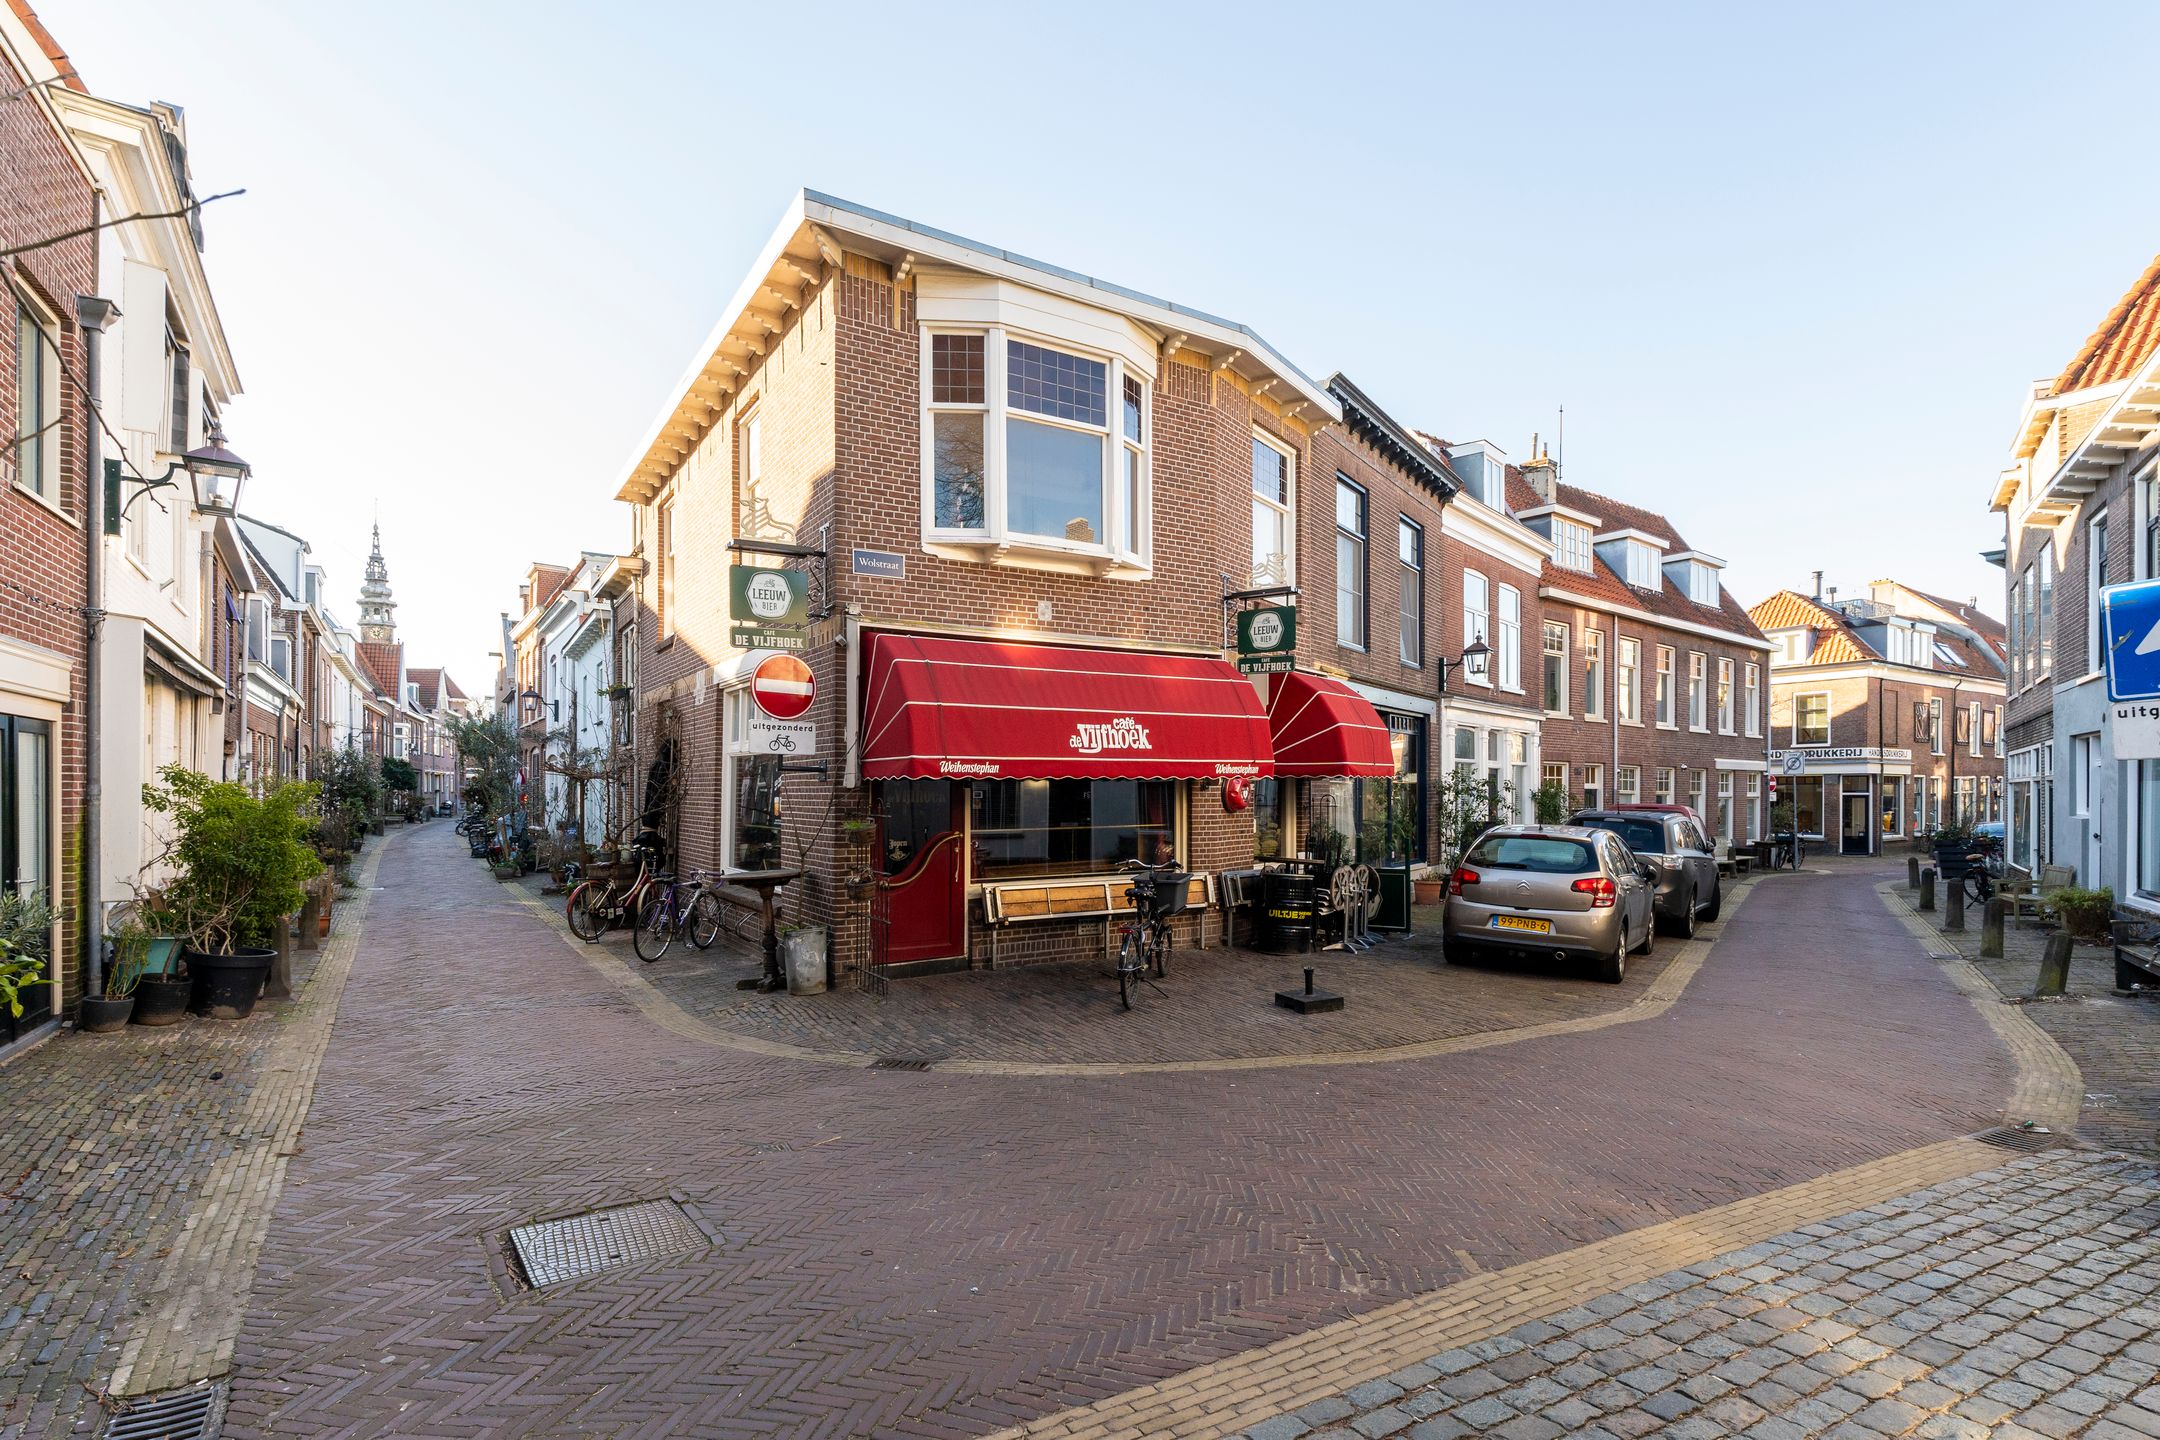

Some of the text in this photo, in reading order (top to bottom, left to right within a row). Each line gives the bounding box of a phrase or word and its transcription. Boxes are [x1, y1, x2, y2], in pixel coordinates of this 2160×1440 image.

[859, 557, 899, 570] Wolstraat
[752, 588, 786, 601] LEEUW
[762, 601, 778, 611] BIER
[1253, 624, 1279, 636] LEEUW
[735, 634, 804, 648] DE VIJFHOEK
[1240, 661, 1292, 673] DE VIJFHOEK
[752, 722, 813, 732] uitgezonderd
[1113, 717, 1135, 729] café
[1069, 724, 1152, 753] de Vijfhoek
[940, 760, 1000, 775] Weihenstephan
[1215, 763, 1259, 776] Weihenstephan
[1269, 909, 1298, 919] UILTJE
[1501, 917, 1547, 931] 99-PNB-6
